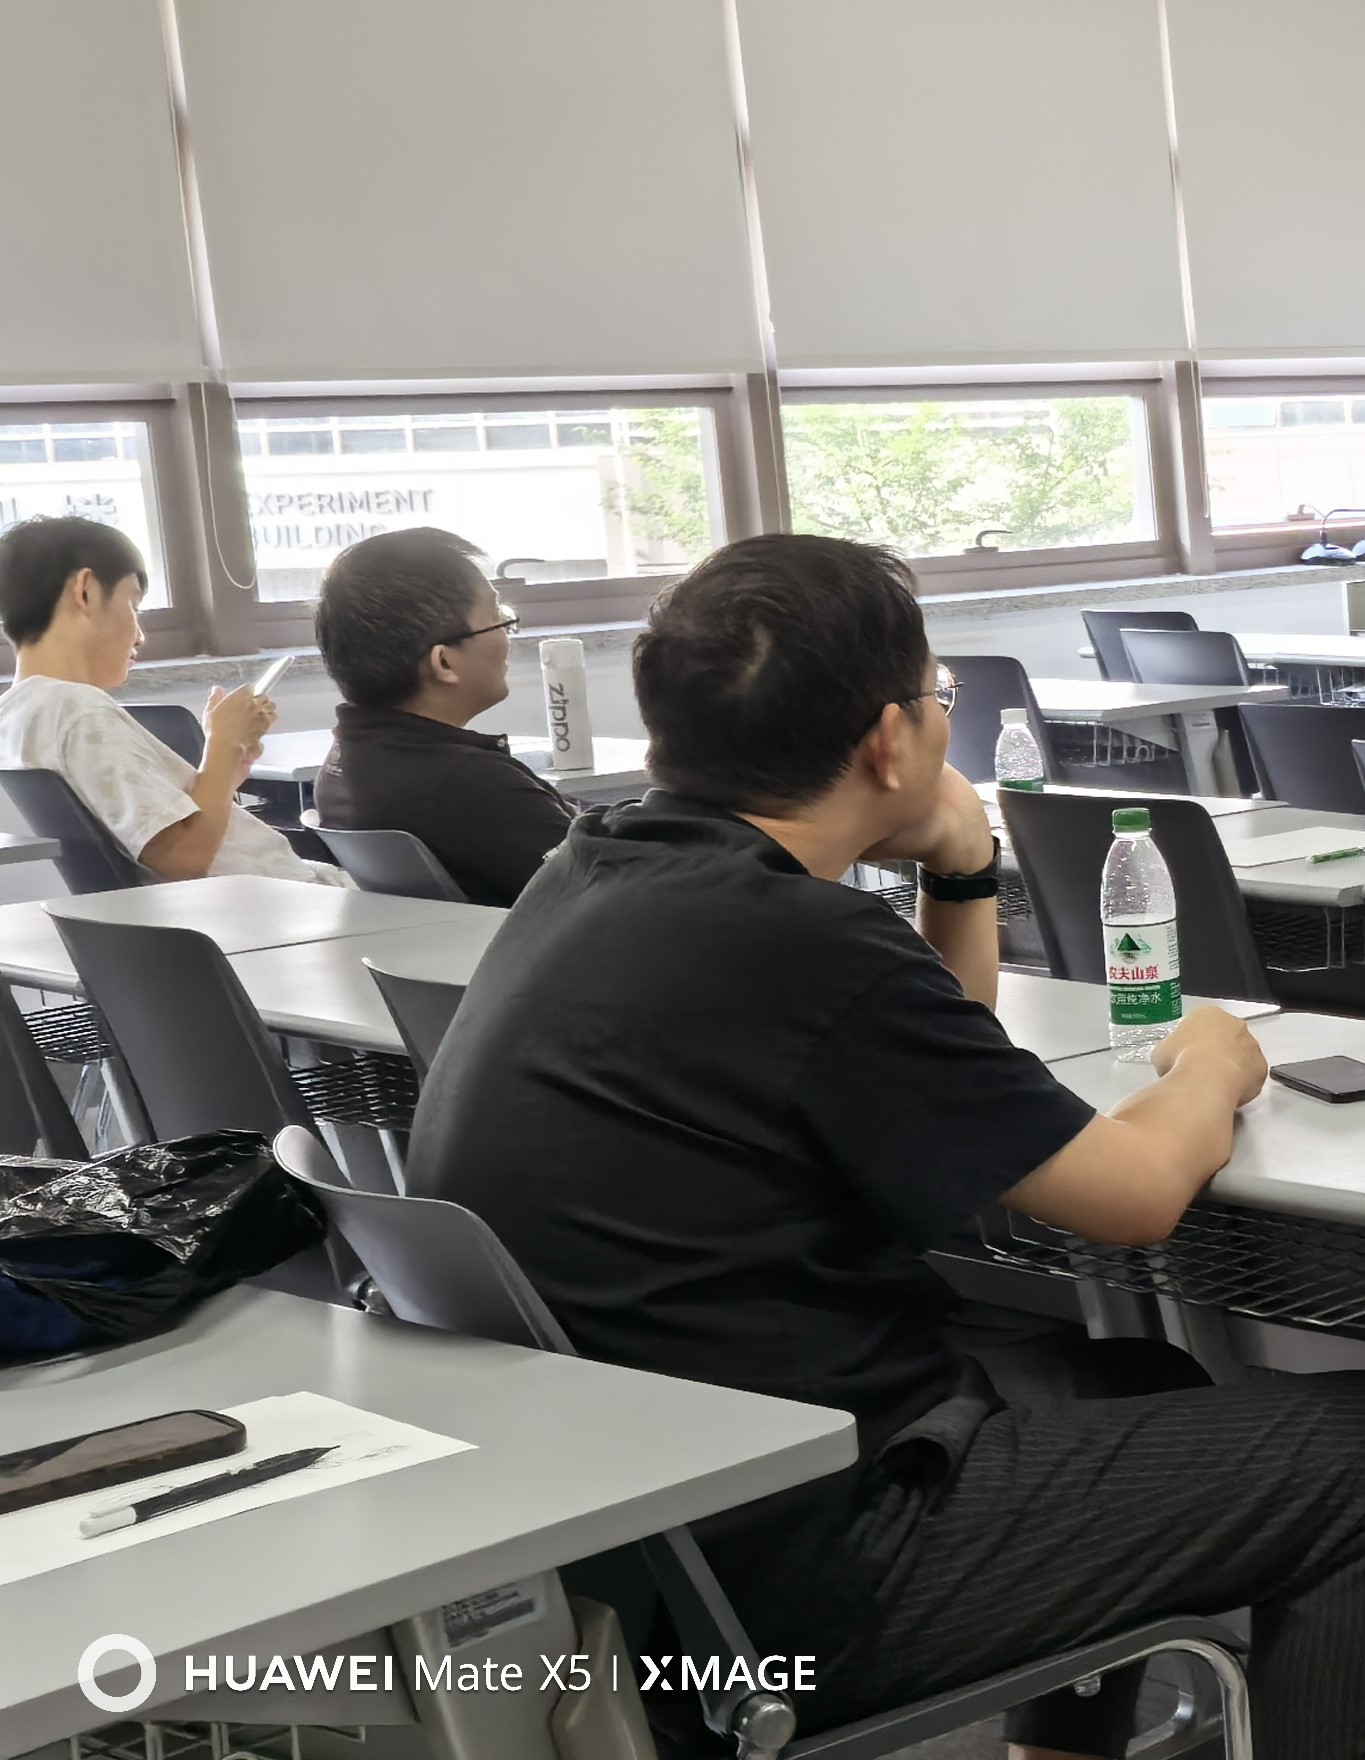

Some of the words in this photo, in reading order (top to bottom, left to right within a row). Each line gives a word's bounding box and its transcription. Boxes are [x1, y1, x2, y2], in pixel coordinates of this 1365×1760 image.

[253, 488, 434, 516] XPERIMENT
[253, 523, 388, 550] UILDIN
[1109, 965, 1159, 980] 农夫山泉
